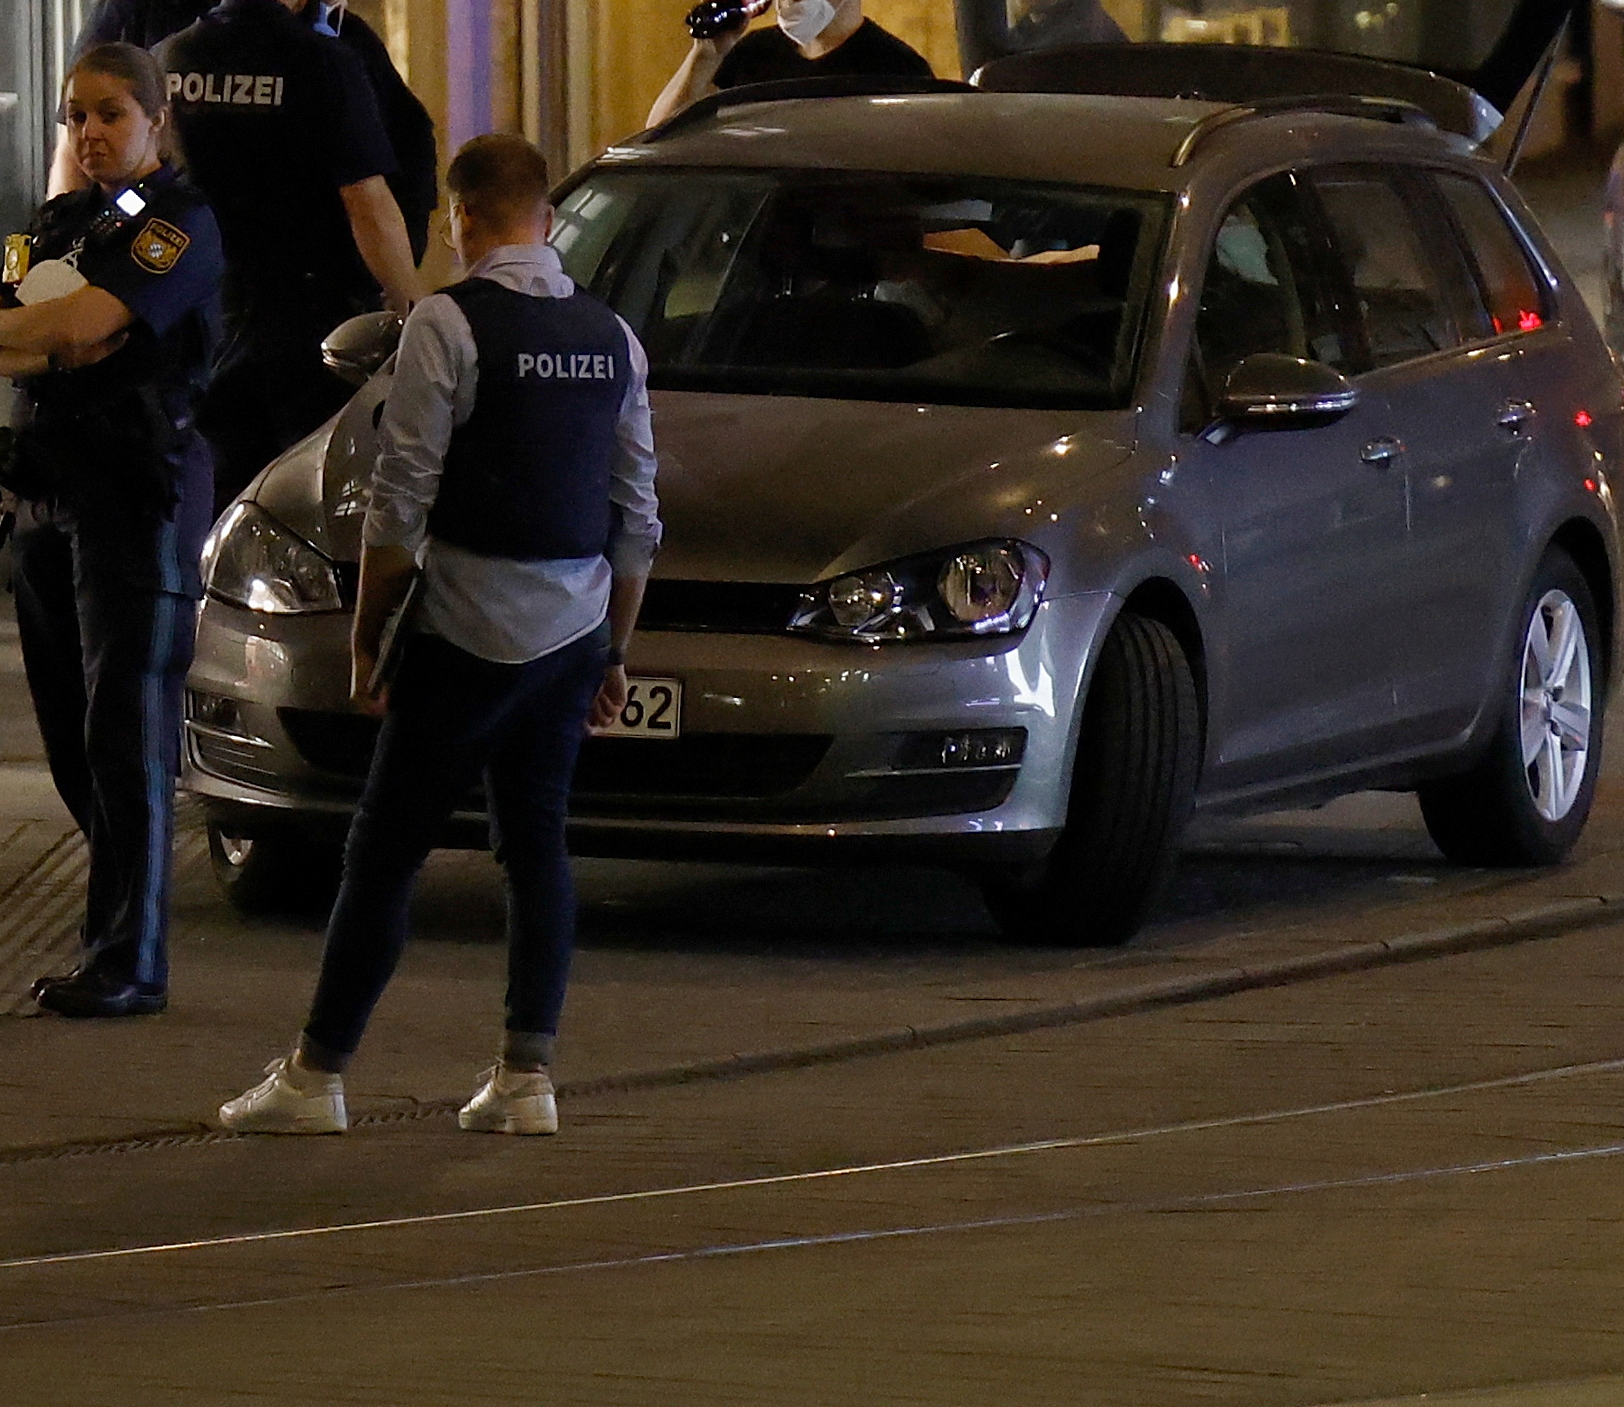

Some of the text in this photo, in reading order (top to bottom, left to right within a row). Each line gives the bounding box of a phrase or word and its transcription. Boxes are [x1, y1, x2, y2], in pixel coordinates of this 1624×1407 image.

[165, 72, 285, 106] POLIZEI
[516, 352, 616, 380] POLIZEI
[620, 684, 673, 730] 62
